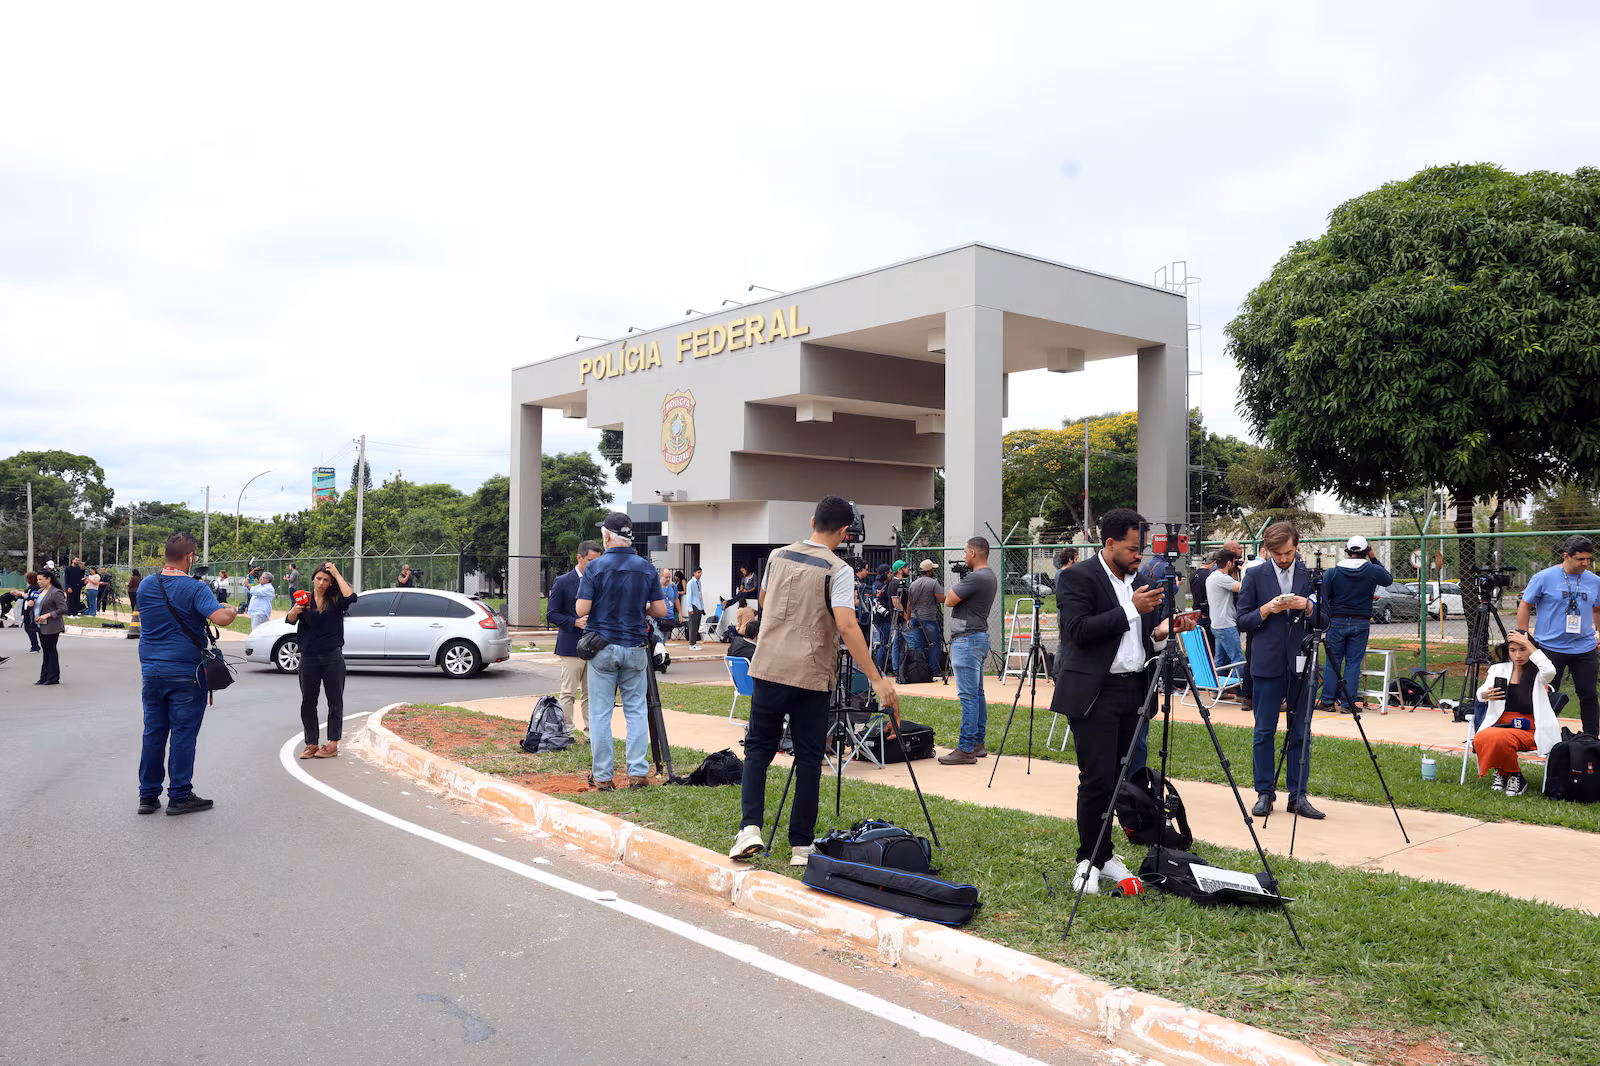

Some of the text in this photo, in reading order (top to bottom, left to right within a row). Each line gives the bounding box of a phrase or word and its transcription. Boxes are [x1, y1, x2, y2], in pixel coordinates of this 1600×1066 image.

[579, 305, 810, 385] POLÍCIA FEDERAL
[665, 451, 689, 463] FEDERAL
